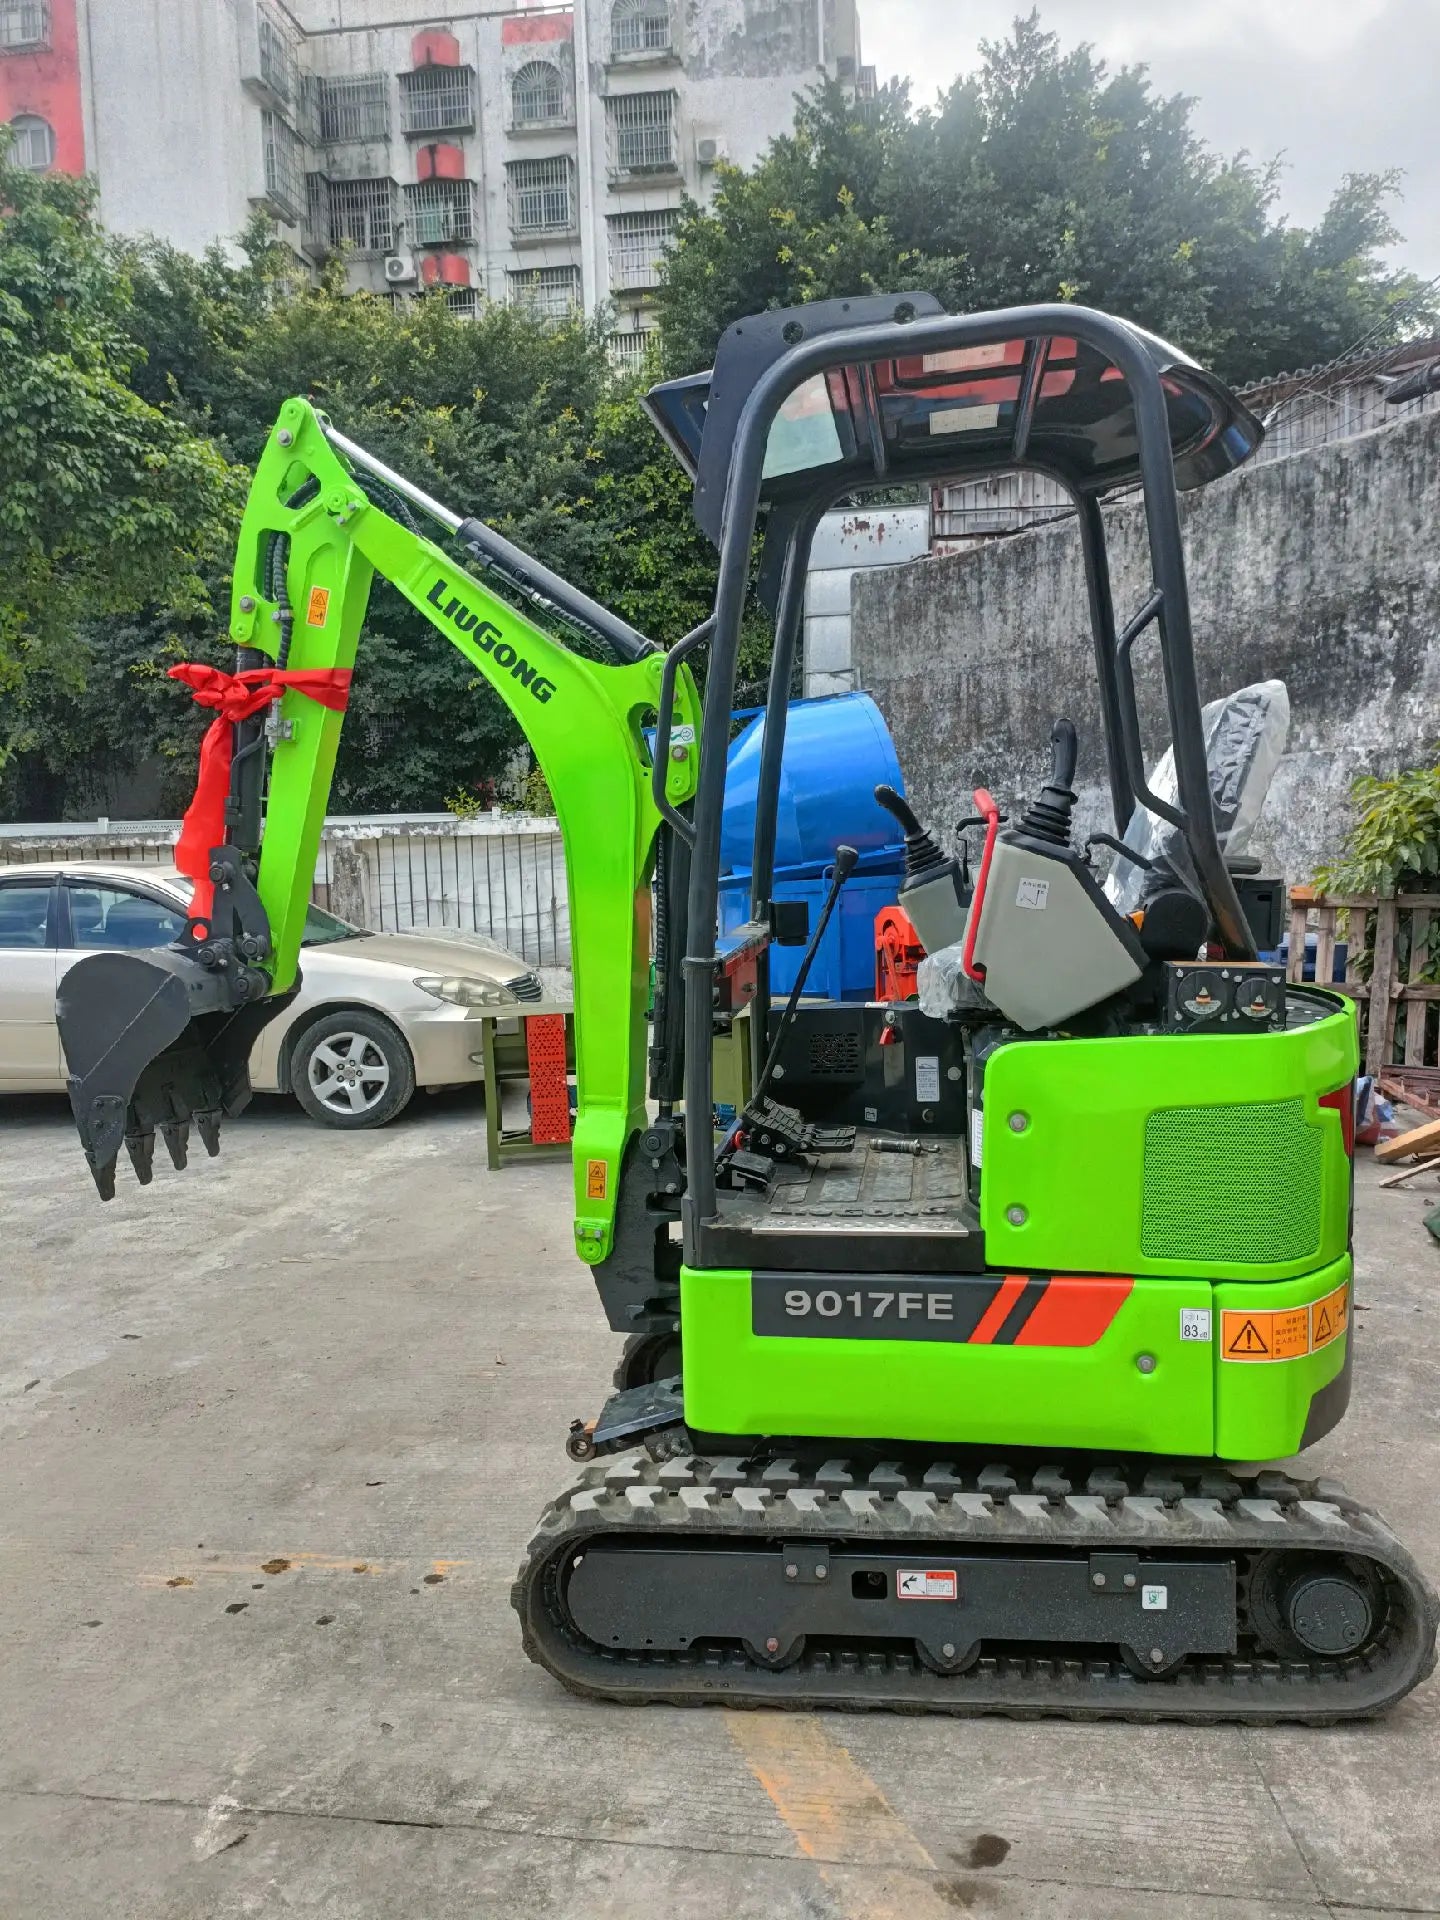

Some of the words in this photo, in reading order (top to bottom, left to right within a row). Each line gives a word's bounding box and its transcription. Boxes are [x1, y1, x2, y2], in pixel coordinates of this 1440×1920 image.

[427, 578, 557, 704] LIUGONG
[784, 1290, 954, 1320] 9017FE
[1184, 1324, 1198, 1337] 83
